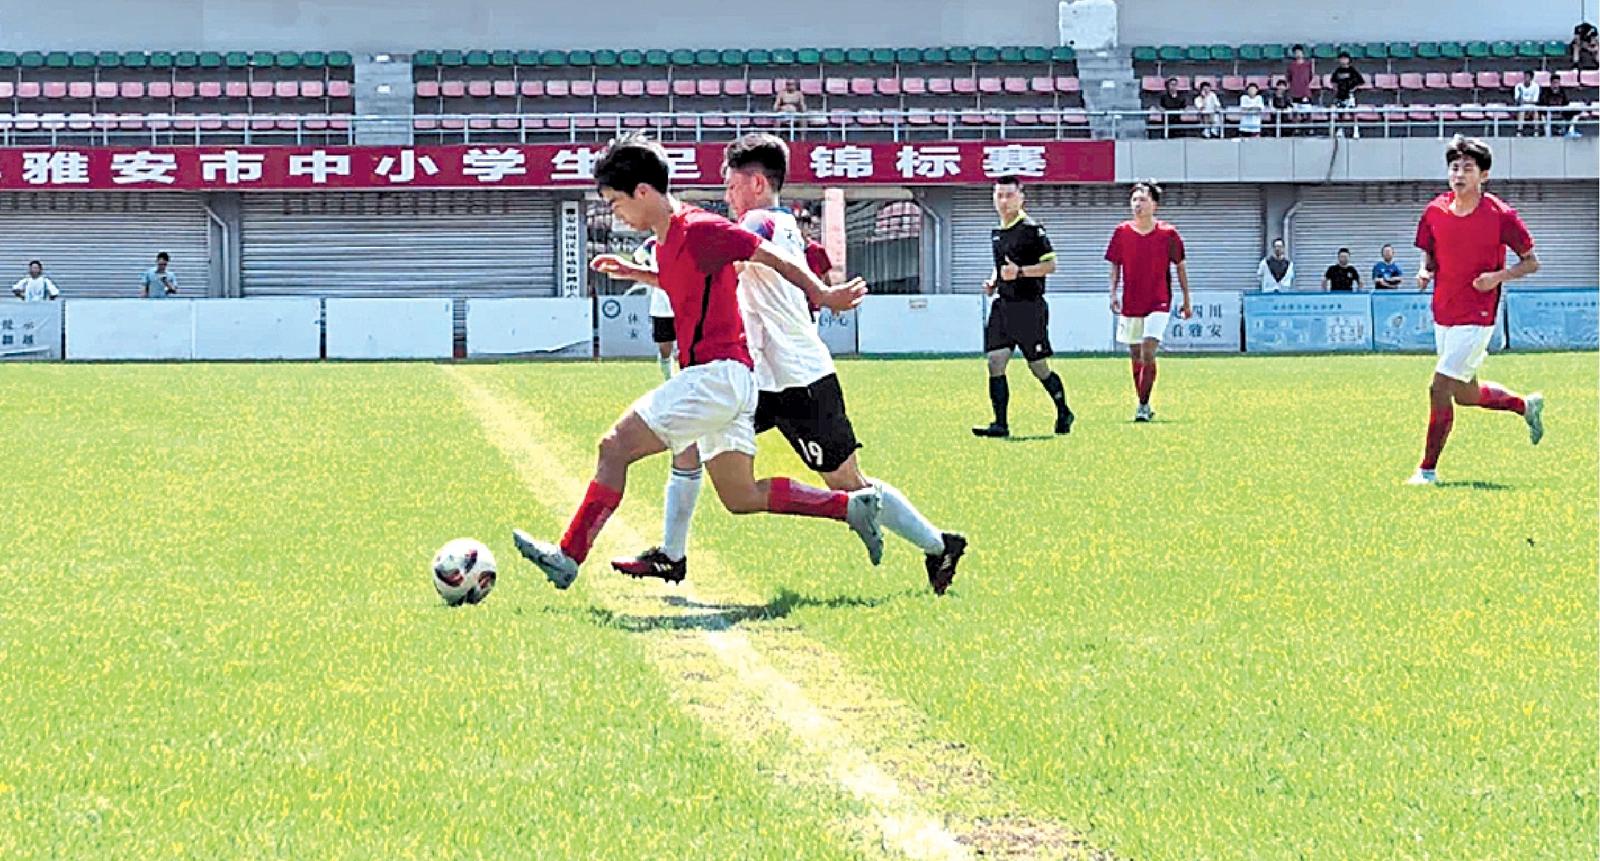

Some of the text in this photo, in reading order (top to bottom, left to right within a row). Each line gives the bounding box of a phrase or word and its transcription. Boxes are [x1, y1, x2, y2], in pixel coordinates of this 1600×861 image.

[22, 145, 1046, 184] 雅安市中小学生足锦标赛
[798, 437, 823, 466] 19
